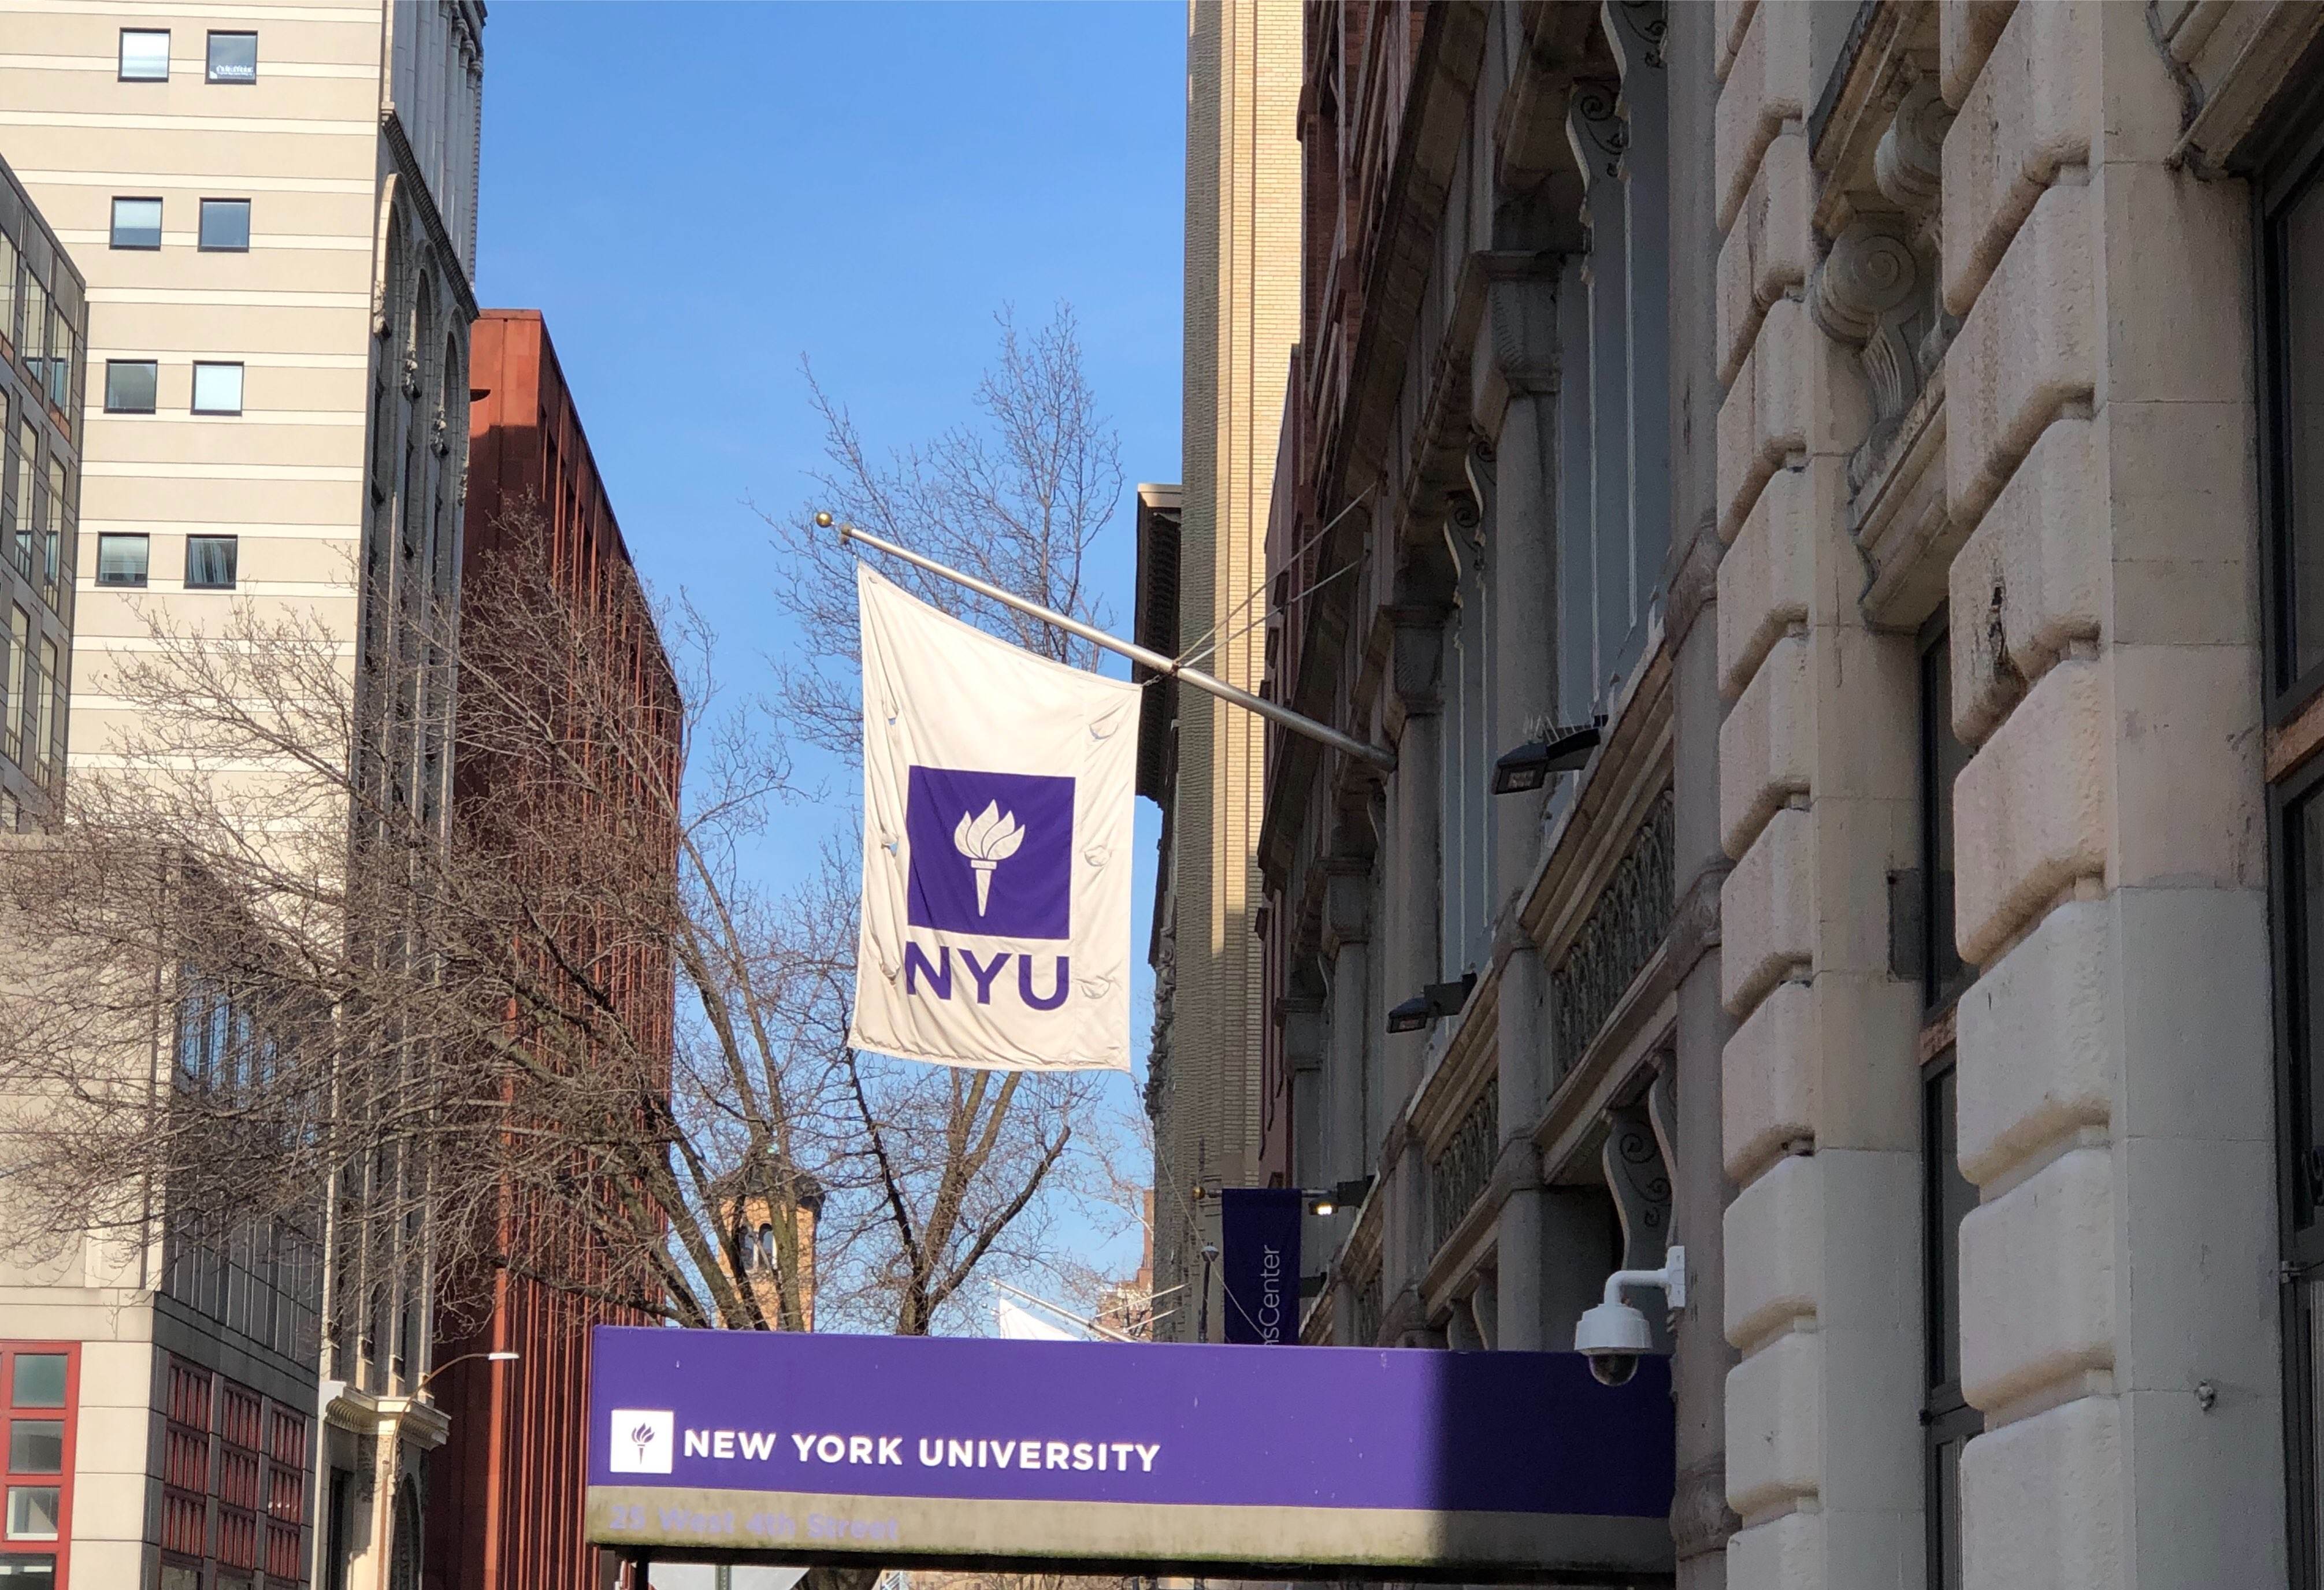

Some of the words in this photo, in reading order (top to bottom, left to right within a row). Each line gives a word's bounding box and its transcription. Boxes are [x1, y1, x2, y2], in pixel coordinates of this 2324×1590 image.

[905, 941, 1070, 1011] NYU
[684, 1429, 777, 1461] NEW
[790, 1433, 903, 1465] YORK
[918, 1437, 1161, 1472] UNIVERSITY
[610, 1504, 645, 1529] 25
[659, 1507, 734, 1534] West
[746, 1512, 795, 1535] 4th
[808, 1513, 900, 1541] Street
